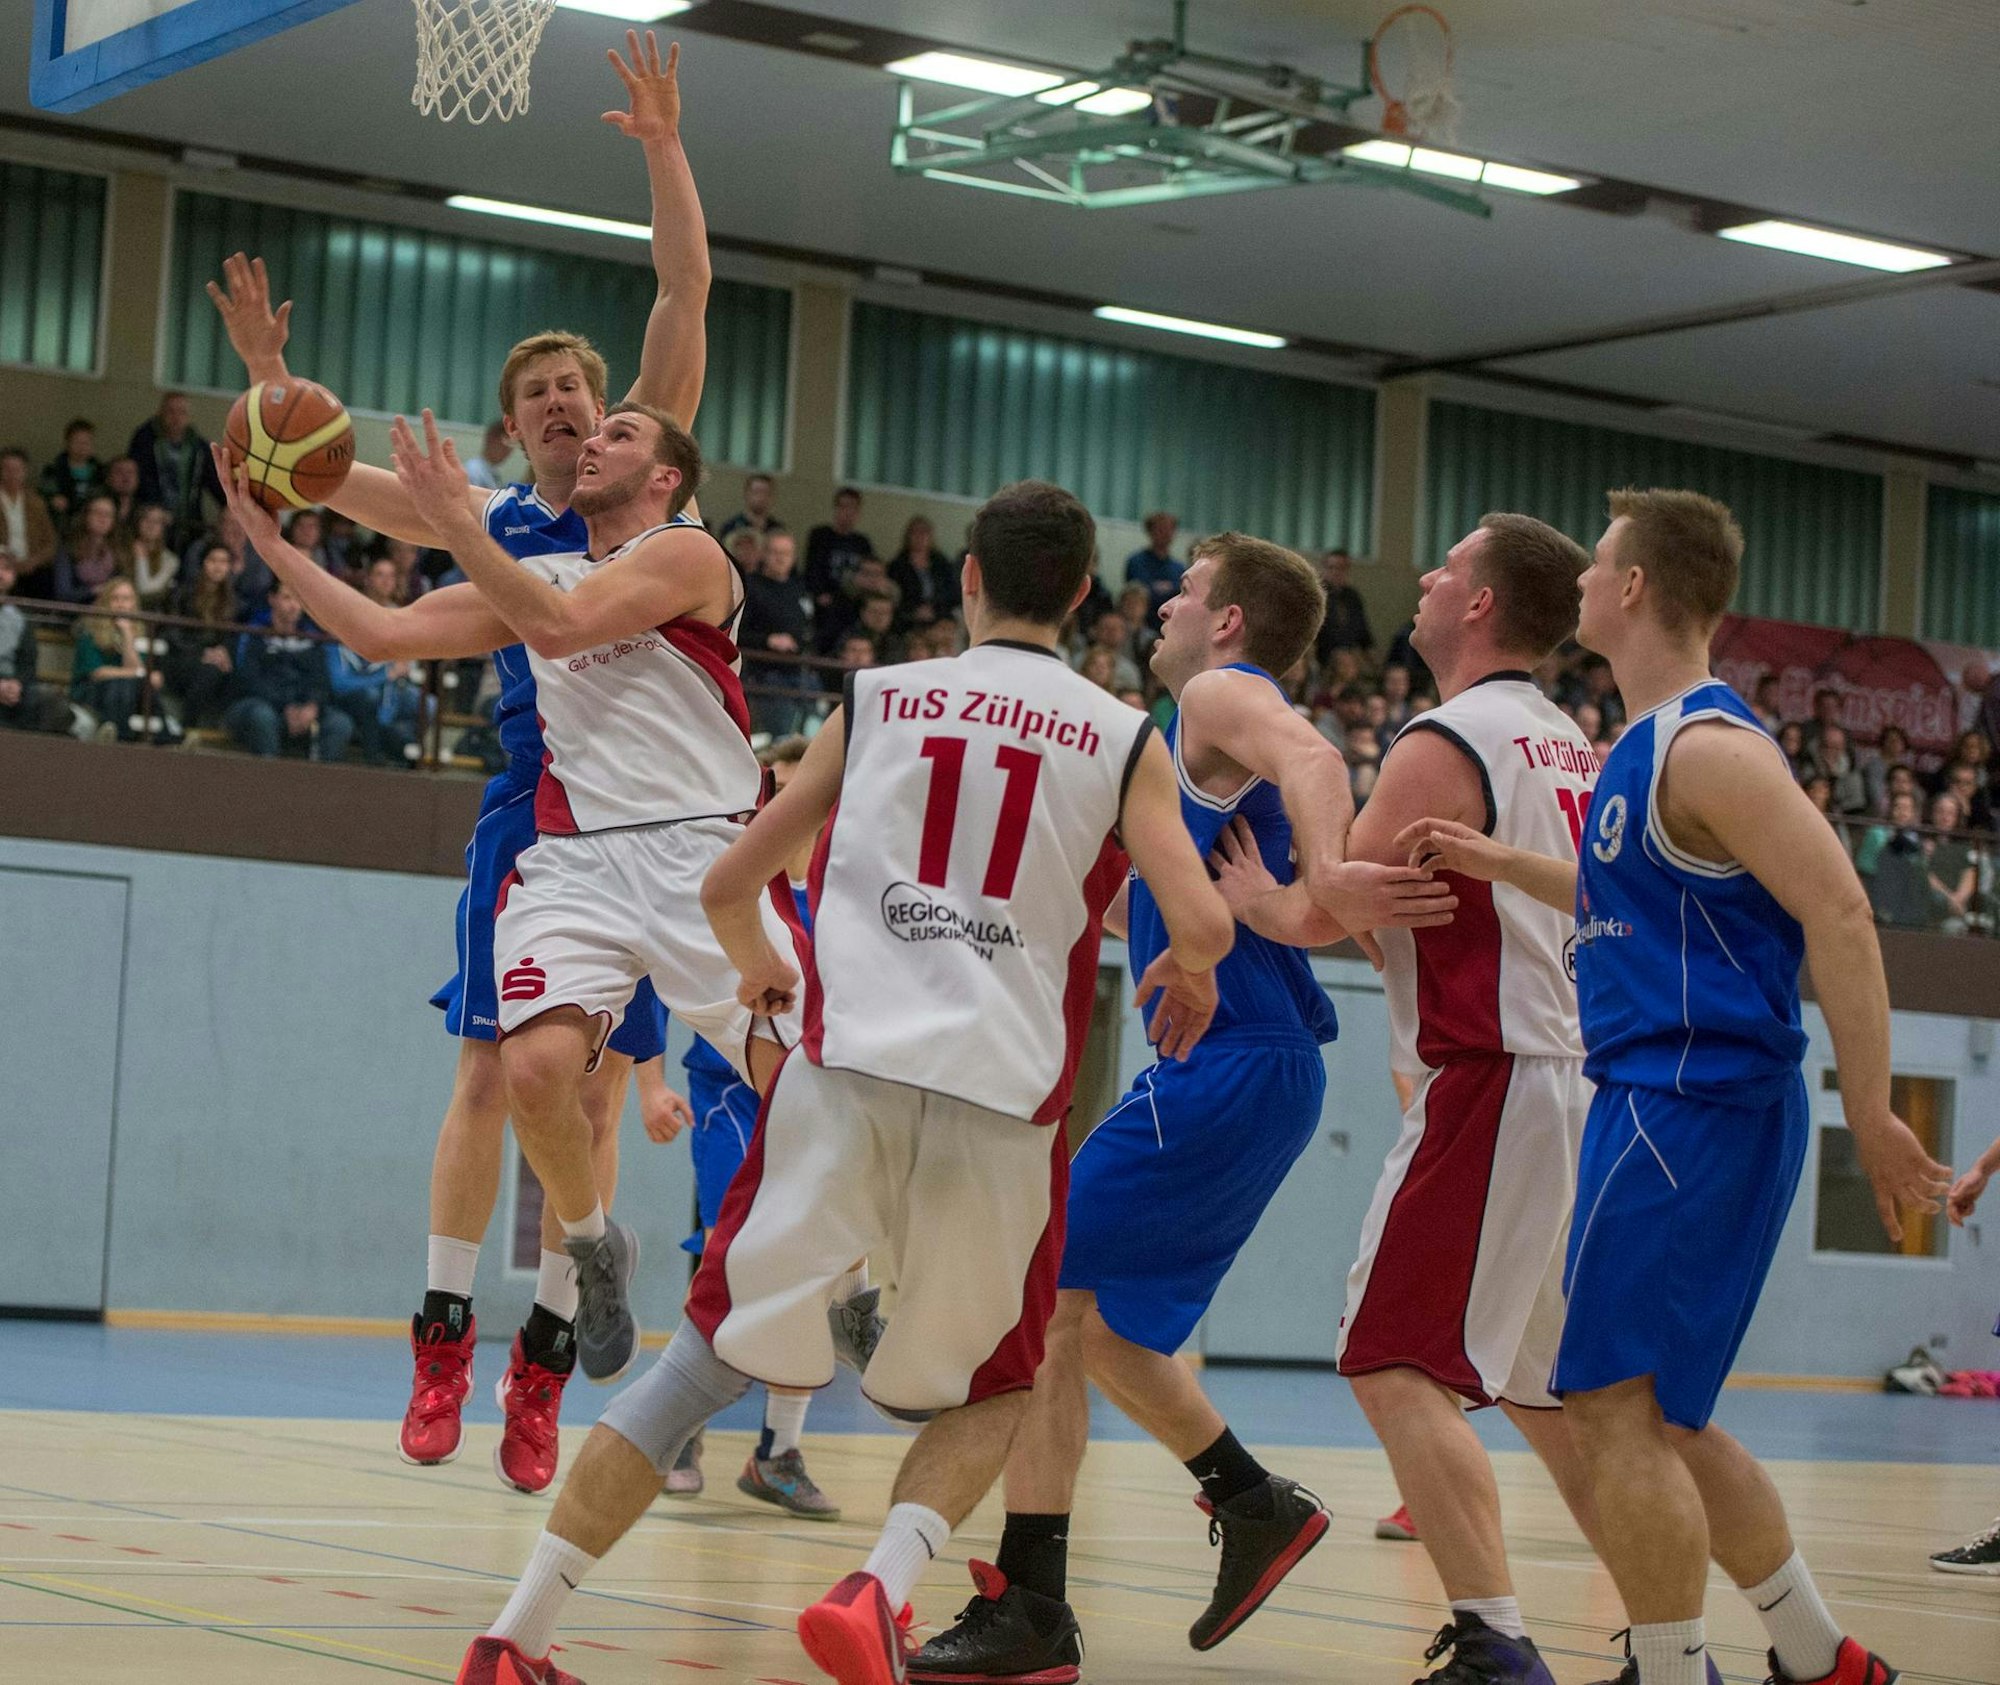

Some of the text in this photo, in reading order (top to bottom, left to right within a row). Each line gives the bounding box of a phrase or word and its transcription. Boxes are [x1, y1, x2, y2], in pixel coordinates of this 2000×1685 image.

[568, 654, 590, 672] Gut
[880, 688, 1101, 757] TuS Zülpich
[918, 736, 1043, 901] 11
[1593, 794, 1627, 863] 9
